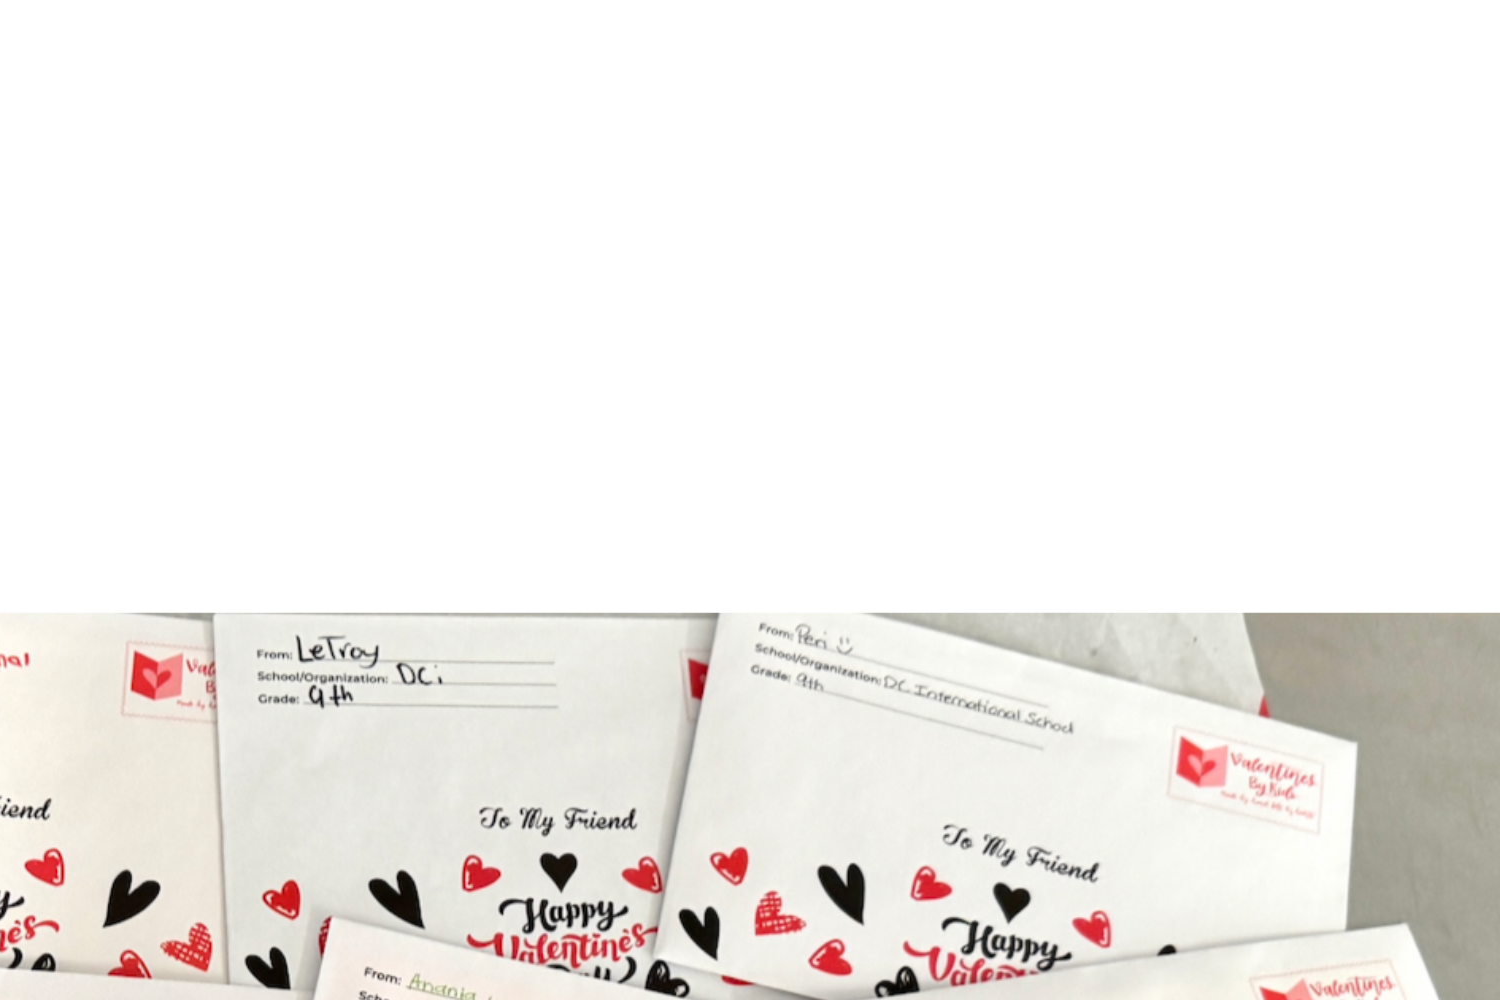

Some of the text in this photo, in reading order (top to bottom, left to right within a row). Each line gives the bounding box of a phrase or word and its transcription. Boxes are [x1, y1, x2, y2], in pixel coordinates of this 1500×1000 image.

[758, 622, 794, 641] From:
[257, 635, 380, 668] From: LeTroy
[754, 642, 882, 687] School/Organization:
[257, 671, 389, 686] School/Organization:
[750, 664, 792, 683] Grade:
[258, 693, 300, 705] Grade:
[480, 806, 638, 836] To My Friend
[942, 824, 1100, 883] To My Friend
[498, 897, 628, 933] Happy
[941, 916, 1073, 972] Happy
[363, 966, 402, 986] From:
